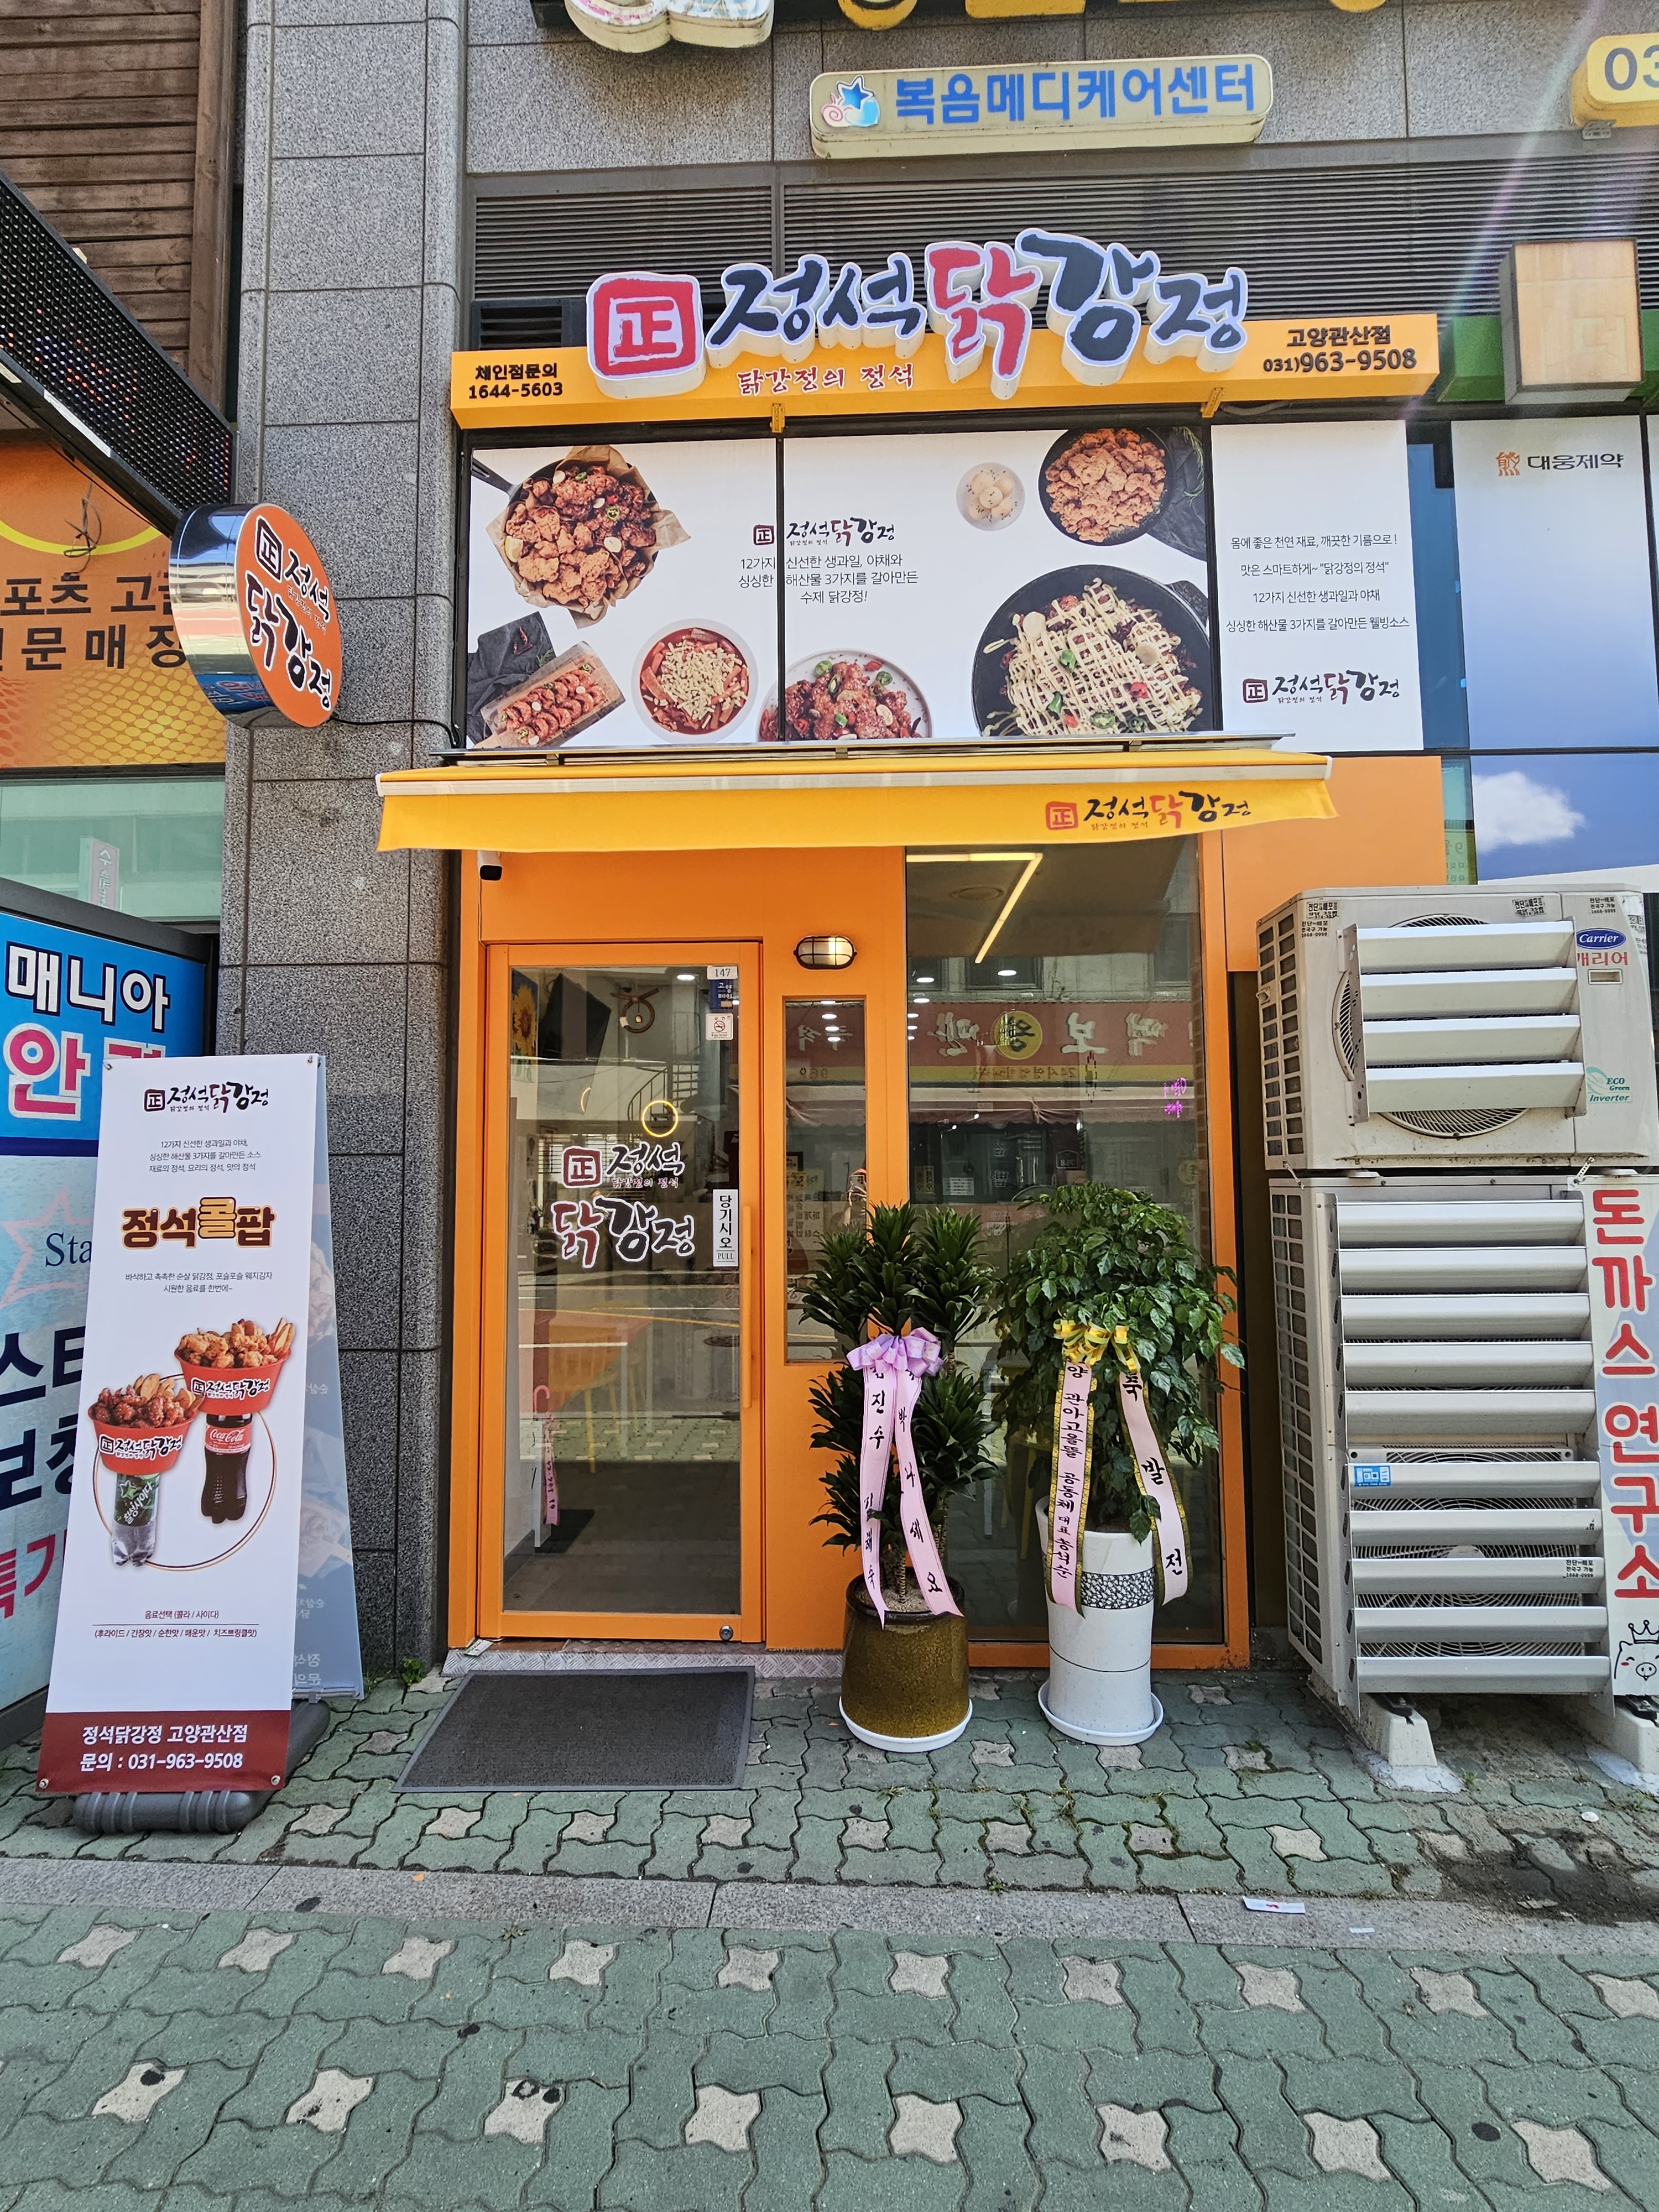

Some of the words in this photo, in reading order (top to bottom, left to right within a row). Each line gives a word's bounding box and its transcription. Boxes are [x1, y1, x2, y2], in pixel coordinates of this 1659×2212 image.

[895, 63, 1255, 125] 복음메디케어센터
[1286, 324, 1391, 347] 고양관산점
[1262, 348, 1418, 373] 031)963-9508
[474, 362, 558, 380] 체인점문의
[737, 366, 846, 395] 닭강정의
[860, 363, 915, 390] 정석
[468, 382, 564, 399] 1644-5603
[1527, 453, 1624, 471] 대웅제약
[786, 517, 895, 547] 정석닭강정
[1231, 537, 1251, 549] 몸에
[1253, 536, 1272, 549] 좋은
[1274, 535, 1295, 549] 천연
[1296, 535, 1318, 548] 재료,
[1321, 534, 1350, 547] 깨끗한
[740, 557, 776, 570] 12가지
[786, 556, 822, 570] 신선한
[825, 554, 863, 568] 생과일,
[867, 553, 902, 567] 야채와
[1241, 564, 1261, 577] 맛은
[1262, 562, 1318, 576] 스마트하게~
[1320, 561, 1363, 575] "닭강정의
[1365, 561, 1389, 573] 정석"
[284, 549, 330, 622] 정석
[738, 574, 774, 588] 싱싱한
[786, 573, 822, 587] 해산물
[825, 572, 867, 586] 3가지를
[871, 571, 919, 585] 갈아만든
[110, 573, 170, 613] 고
[800, 591, 824, 604] 수제
[829, 589, 868, 604] 닭강정!
[1253, 591, 1285, 604] 12가지
[1286, 591, 1316, 603] 신선한
[1318, 589, 1358, 603] 생과일과
[1360, 589, 1380, 601] 야채
[1225, 619, 1256, 633] 싱싱한
[1258, 619, 1288, 632] 해산물
[1290, 618, 1326, 630] 3가지를
[1328, 617, 1368, 630] 갈아만든
[1369, 616, 1410, 629] 웰빙소스
[247, 571, 331, 710] 닭강정
[1272, 669, 1400, 705] 정석닭강정
[1083, 790, 1251, 829] 정석닭강정
[1579, 934, 1619, 943] Carrier
[715, 968, 731, 977] 147
[6, 941, 171, 1034] 매니아
[166, 1081, 269, 1113] 정석닭강정
[160, 1140, 181, 1149] 12가지
[182, 1140, 203, 1148] 신선한
[149, 1152, 169, 1161] 싱싱한
[171, 1152, 191, 1160] 해산물
[192, 1151, 216, 1160] 3가지를
[218, 1151, 246, 1160] 갈아만든
[608, 1143, 685, 1176] 정석
[149, 1165, 169, 1173] 재료의
[187, 1164, 207, 1172] 요리의
[226, 1163, 241, 1172] 맛의
[242, 1162, 256, 1171] 정석
[658, 1177, 679, 1189] 정석
[718, 1194, 733, 1249] 당기시오
[551, 1197, 696, 1268] 닭강정
[717, 1252, 735, 1260] PULL
[125, 1272, 153, 1281] 바삭하고
[176, 1272, 190, 1281] 순살
[216, 1272, 243, 1280] 포슬포슬
[1592, 1188, 1655, 1375] 돈까스
[163, 1284, 184, 1293] 시원한
[186, 1284, 206, 1293] 음료를
[1604, 1405, 1659, 1599] 연구소
[145, 1610, 173, 1619] 음료선택
[131, 1629, 152, 1638] 간장맛
[158, 1629, 179, 1638] 순한맛
[185, 1629, 206, 1637] 매운맛
[82, 1725, 163, 1745] 정석닭강정
[167, 1724, 248, 1744] 고양관산점
[80, 1752, 113, 1772] 문의
[128, 1752, 243, 1770] 031-963-9508
